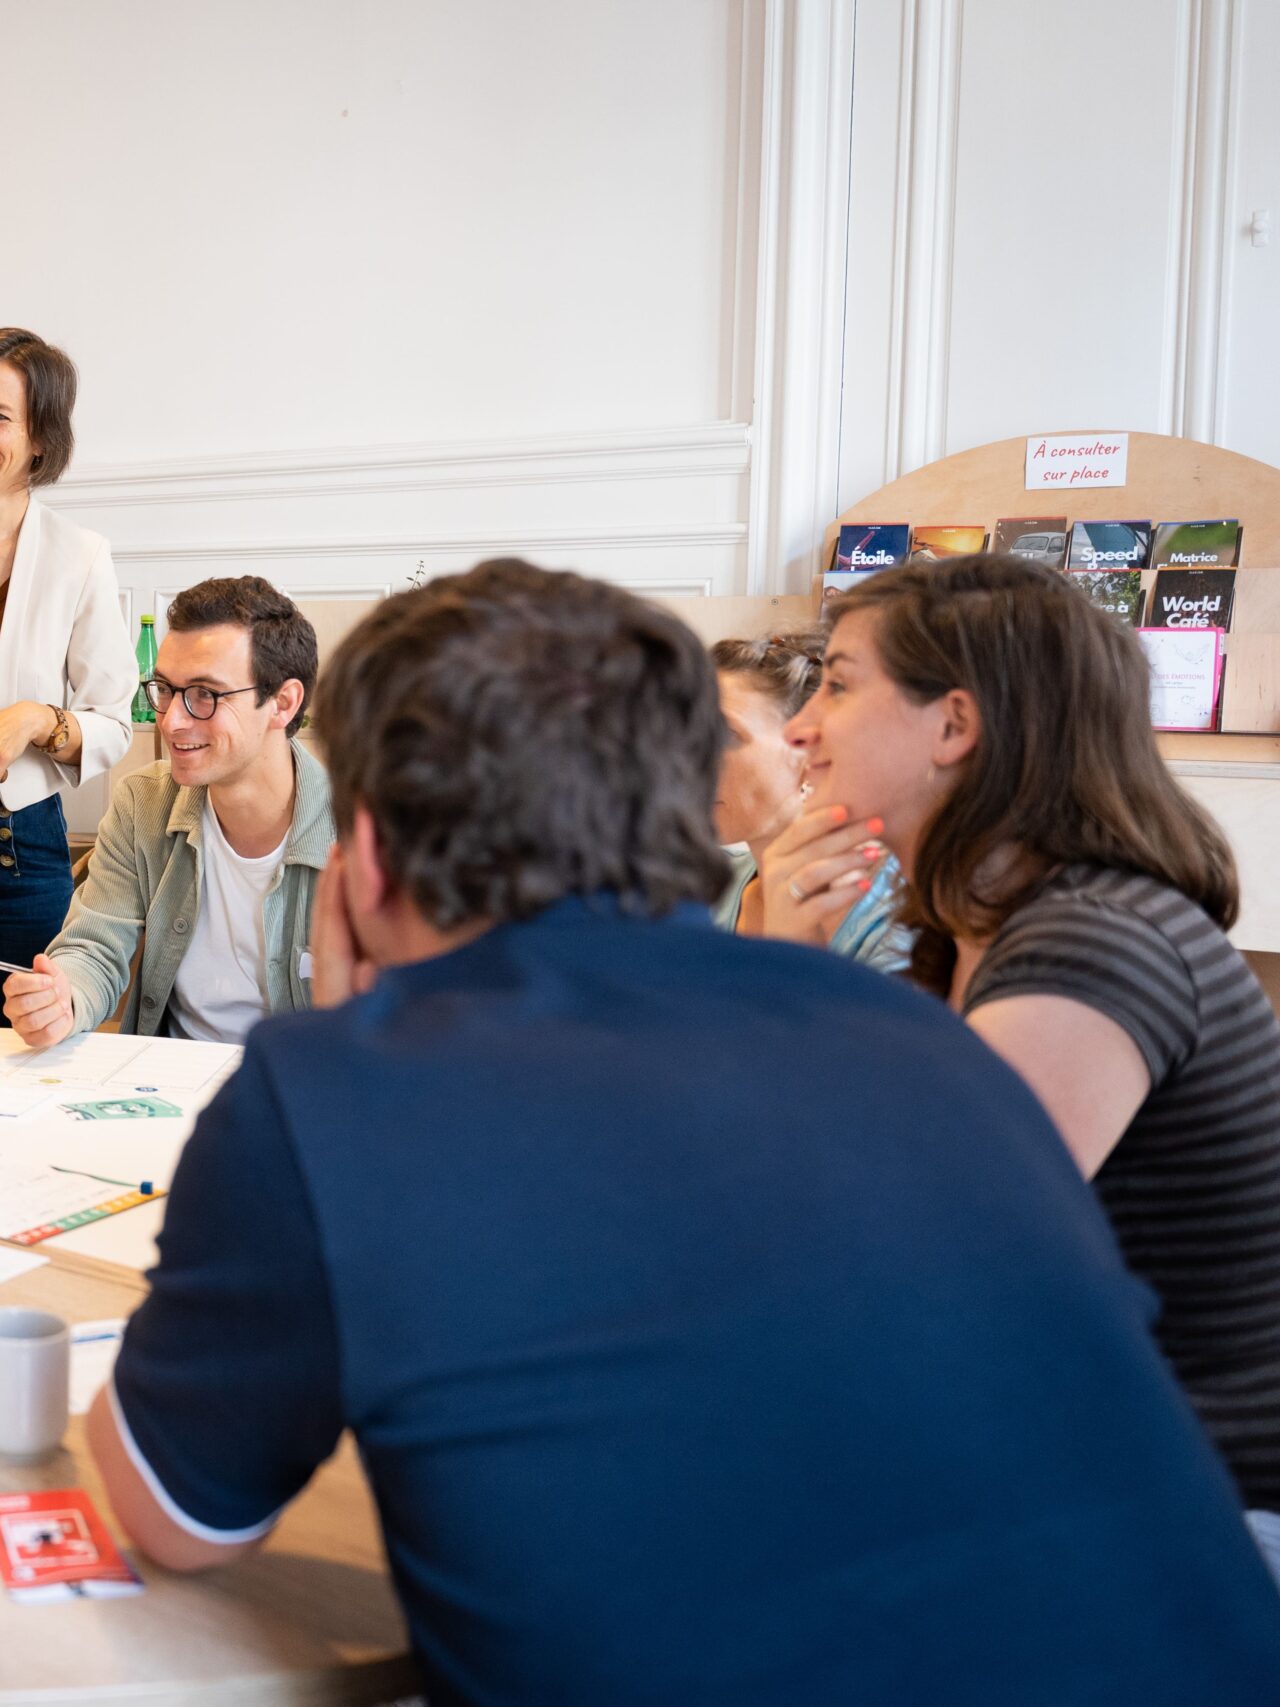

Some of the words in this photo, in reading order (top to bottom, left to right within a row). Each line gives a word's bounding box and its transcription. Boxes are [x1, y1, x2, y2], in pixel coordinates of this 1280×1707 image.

[1033, 440, 1047, 459] À
[1050, 441, 1121, 458] consulter
[1043, 471, 1067, 481] sur
[1069, 465, 1109, 484] place
[851, 545, 895, 565] Étoile
[1080, 546, 1138, 565] Speed
[1170, 552, 1218, 563] Matrice
[1162, 595, 1221, 612] World
[1166, 612, 1210, 628] Café
